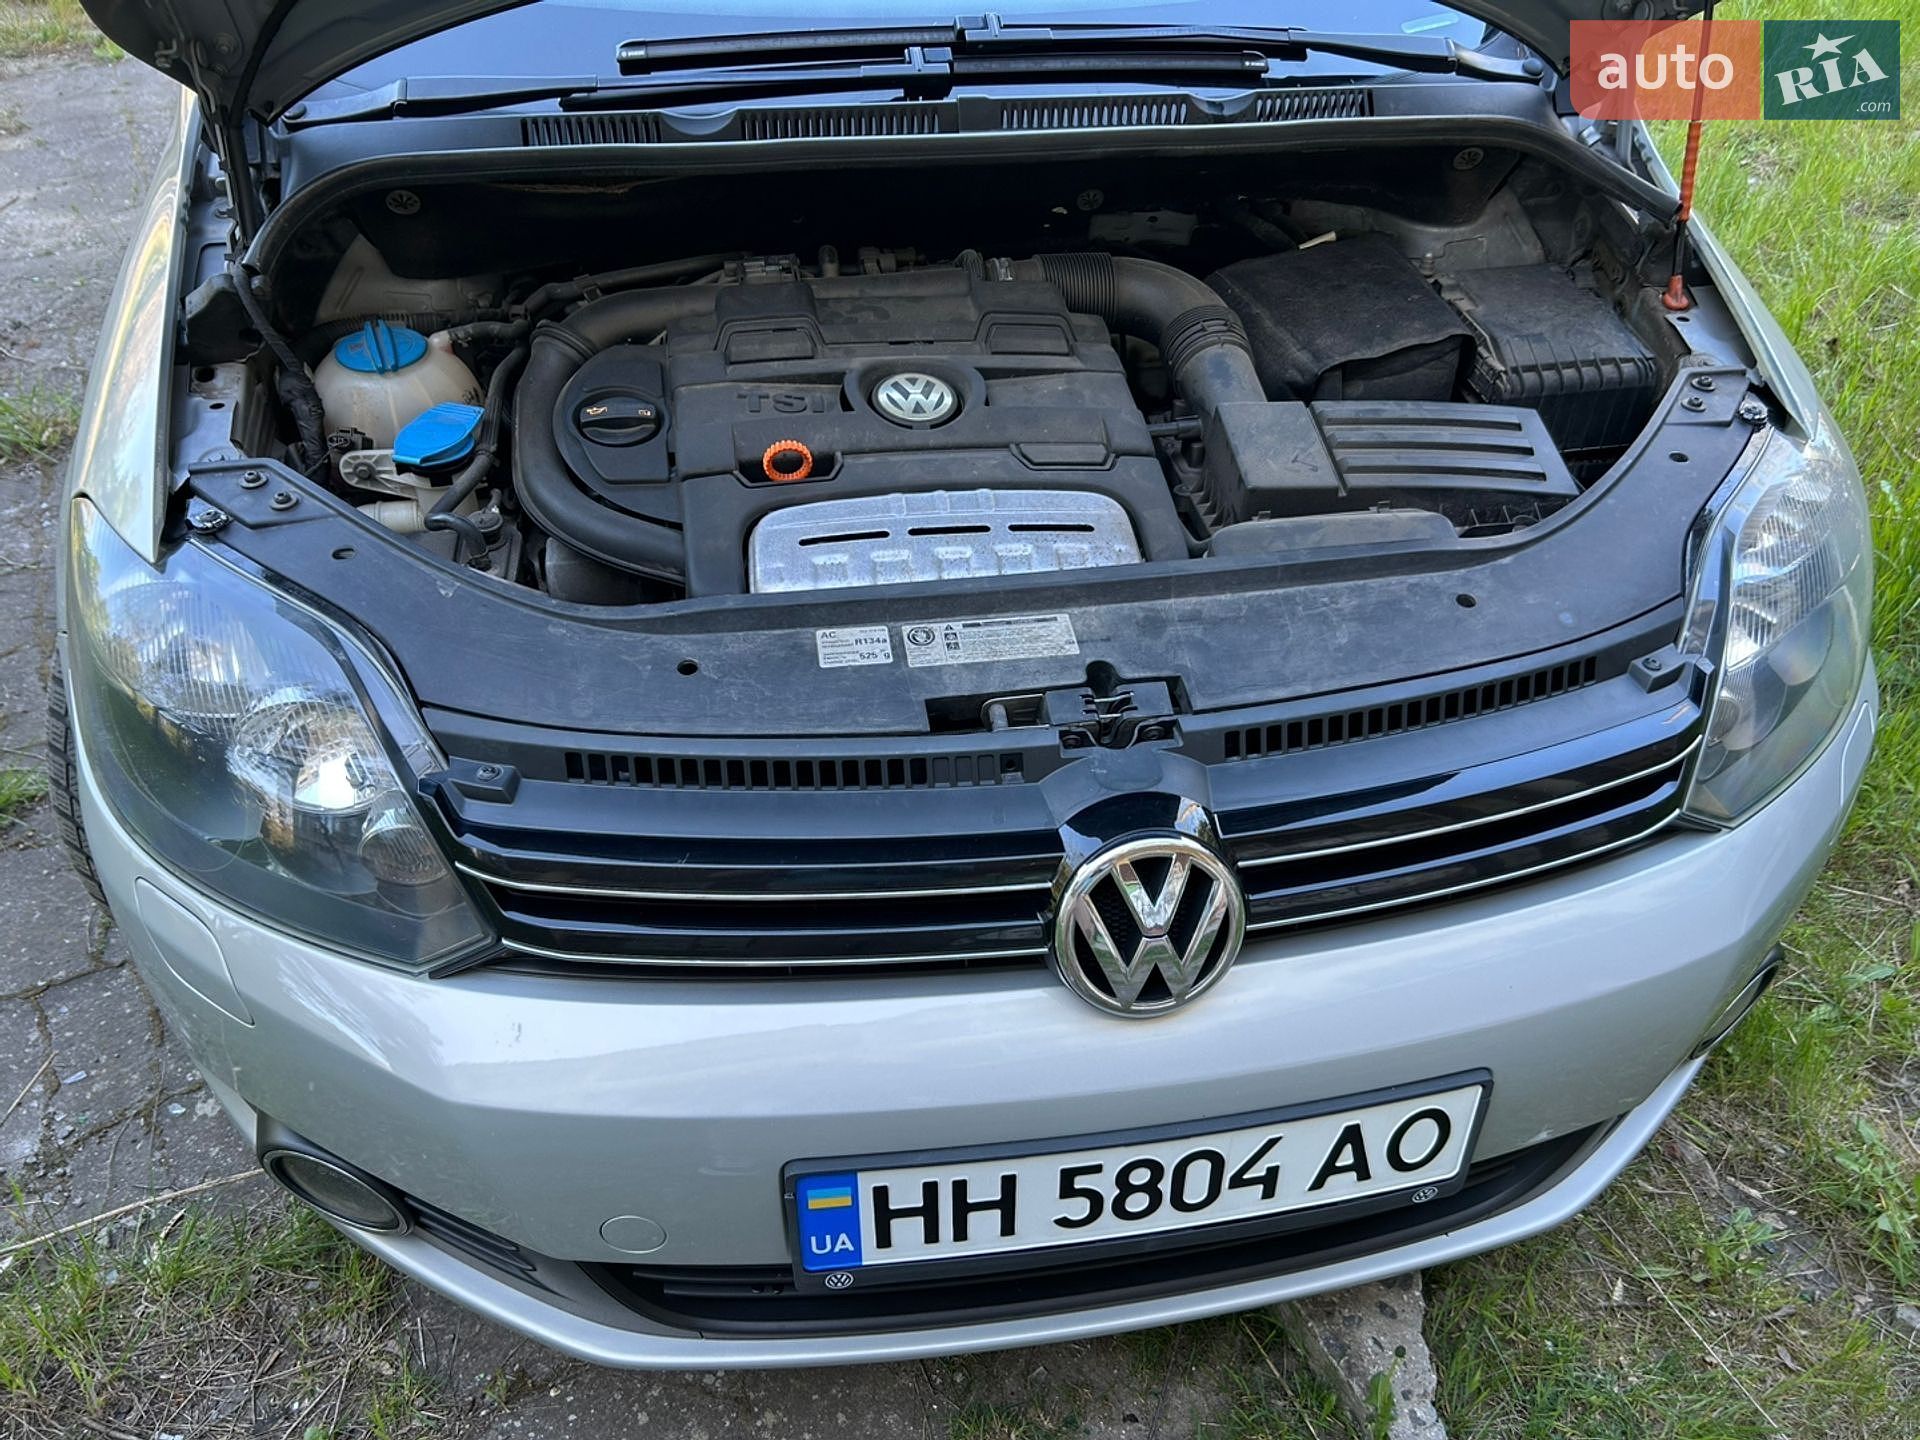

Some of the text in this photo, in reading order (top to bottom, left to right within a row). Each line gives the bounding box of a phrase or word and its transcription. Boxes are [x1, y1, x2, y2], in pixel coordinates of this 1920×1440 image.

[736, 393, 825, 414] TSI
[821, 631, 836, 639] AC
[854, 637, 888, 646] R134a
[859, 652, 878, 660] 525
[1055, 836, 1246, 1018] VW
[871, 1106, 1452, 1250] HH 5804 AO
[810, 1232, 855, 1255] UA
